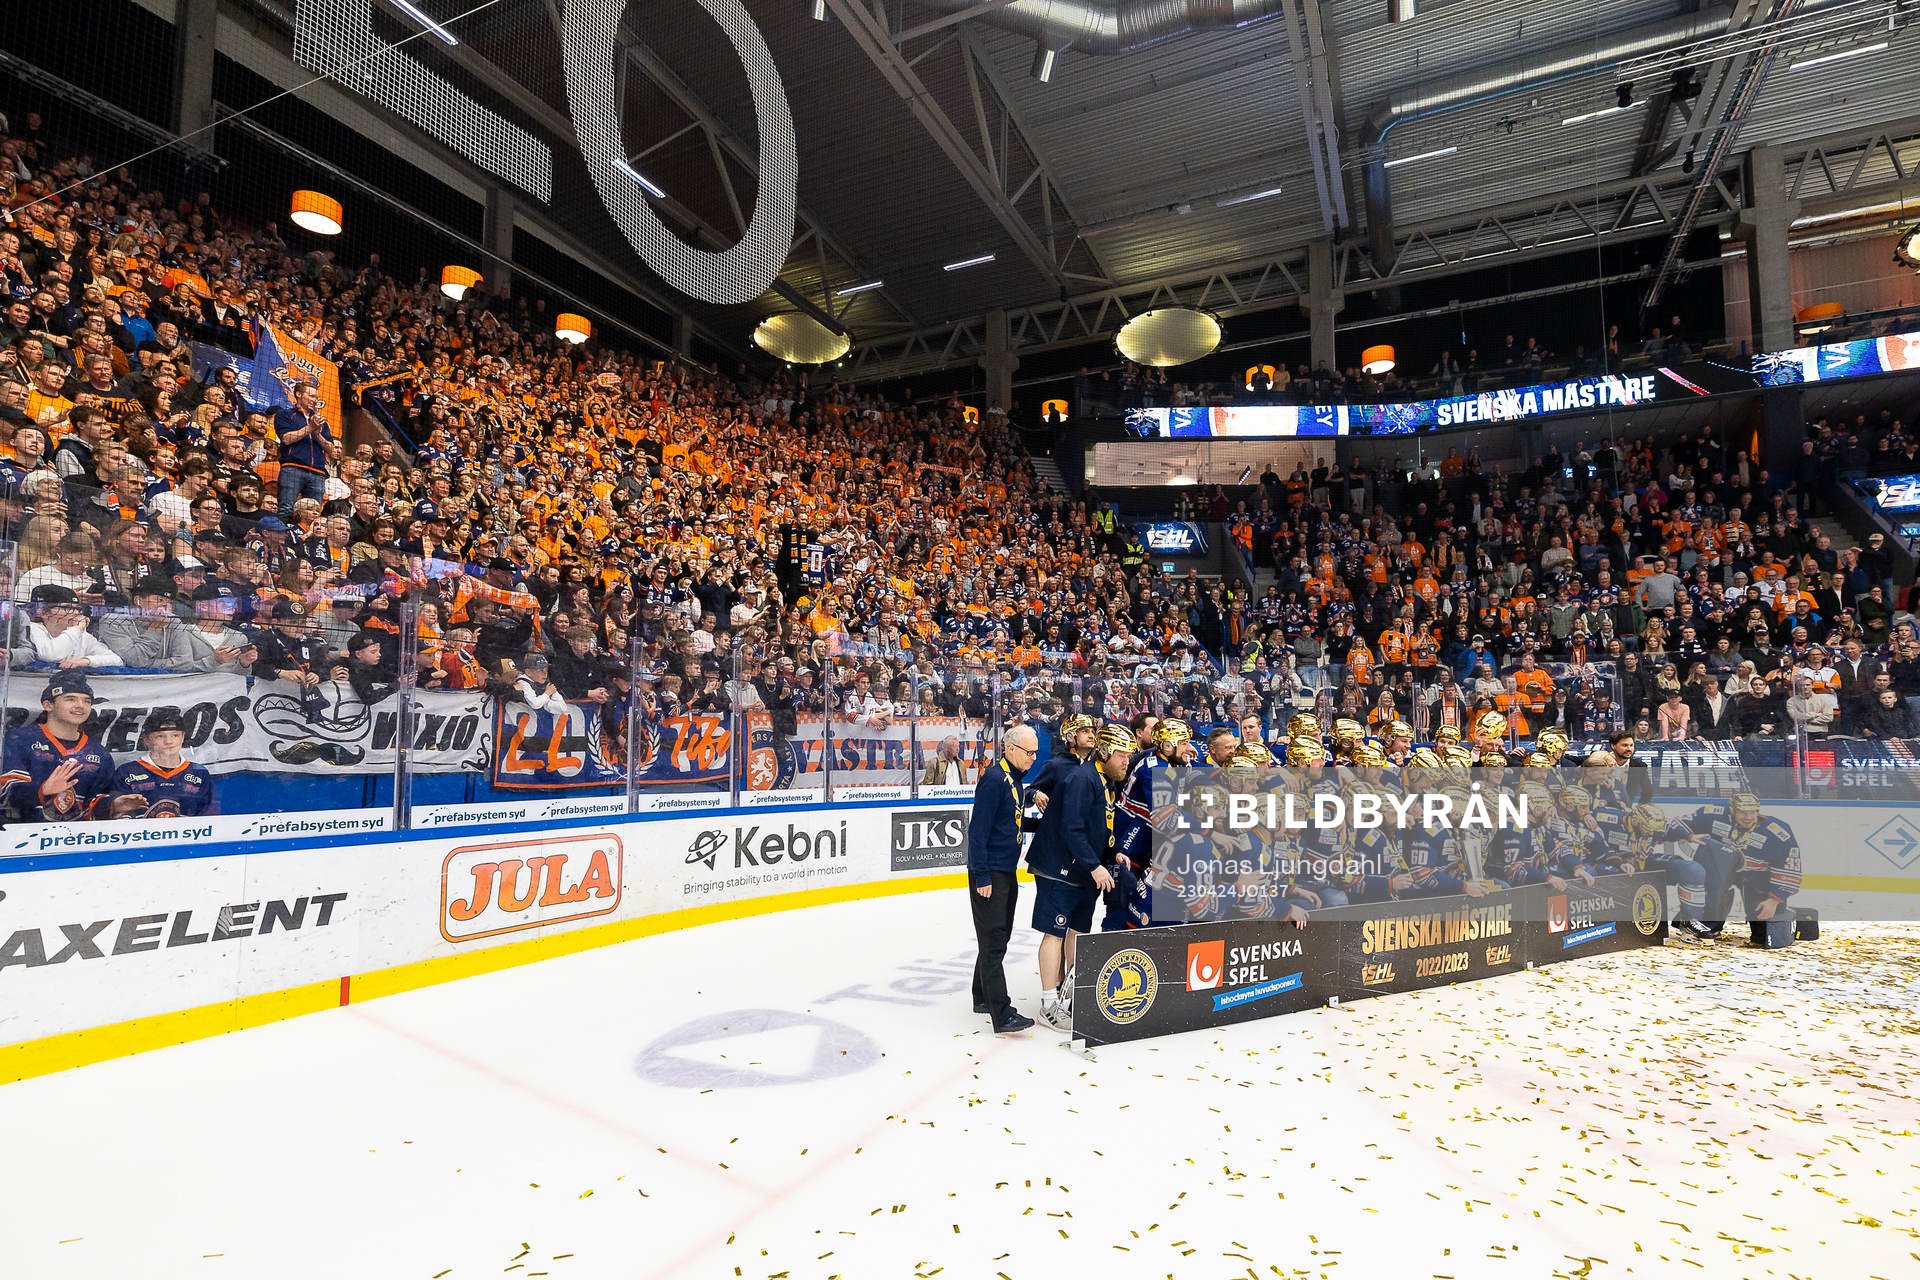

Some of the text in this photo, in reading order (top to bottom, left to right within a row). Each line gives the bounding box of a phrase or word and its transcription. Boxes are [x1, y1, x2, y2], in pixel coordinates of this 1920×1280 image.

[1437, 376, 1656, 426] SVENSKA MÄSTARE
[1149, 528, 1194, 547] SHL
[1842, 773, 1894, 787] SPEL
[658, 798, 721, 808] prefabsystem syd
[756, 793, 813, 804] prefabsystem syd
[849, 791, 901, 801] prefabsystem syd
[434, 808, 526, 826] prefabsystem syd
[550, 803, 624, 817] prefabsystem syd
[259, 817, 384, 836] prefabsystem syd
[895, 819, 964, 851] JKS
[39, 826, 213, 851] prefabsystem syd
[734, 820, 847, 869] Kebni
[449, 849, 616, 922] JULA
[683, 864, 848, 895] Bringing stability to a world in motion
[1569, 897, 1616, 915] SVENSKA
[0, 892, 348, 971] AXELENT
[1362, 903, 1513, 955] SVENSKA MÄSTARE
[1570, 914, 1595, 930] SPEL
[1229, 939, 1303, 966] SVENSKA
[1364, 944, 1512, 984] SHL 2022/2023 SHL
[1229, 965, 1268, 986] SPEL
[1255, 978, 1296, 999] huvudsponsor
